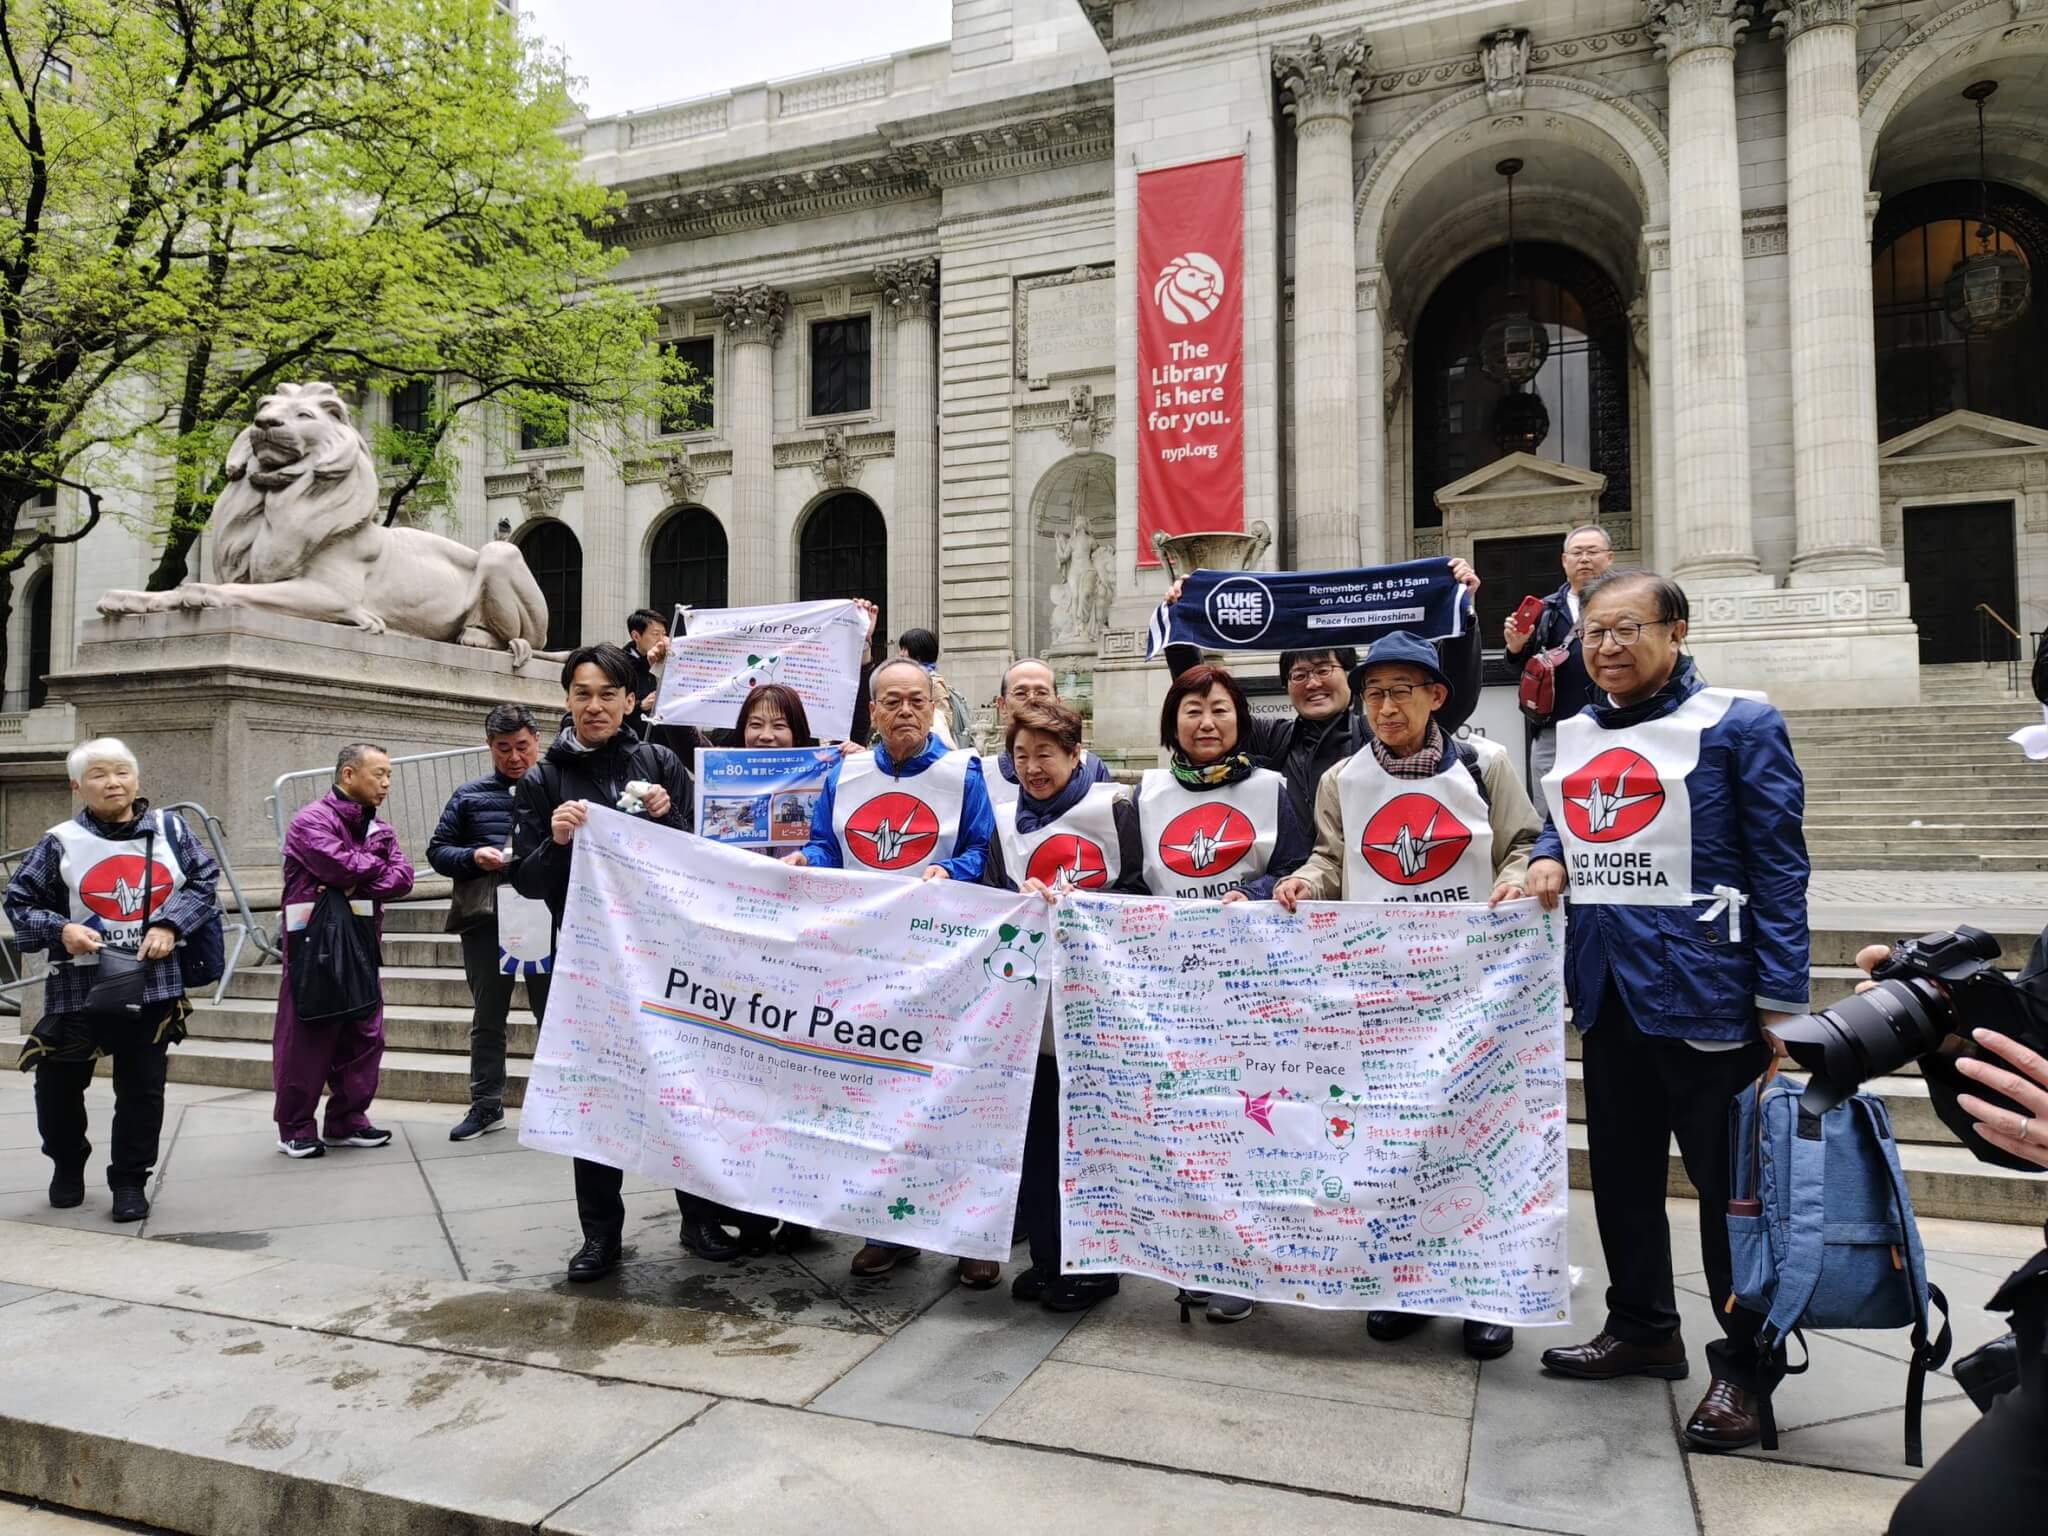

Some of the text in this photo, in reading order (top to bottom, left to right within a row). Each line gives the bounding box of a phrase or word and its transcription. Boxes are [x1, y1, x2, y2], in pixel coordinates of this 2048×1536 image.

[1168, 341, 1209, 361] The
[1152, 362, 1228, 386] Library
[1155, 386, 1225, 408] is here
[1148, 410, 1231, 433] for you.
[1161, 443, 1218, 461] nypl.org
[1372, 582, 1383, 590] at
[1386, 578, 1430, 589] 8:15am
[1216, 591, 1262, 608] NUKE
[1336, 594, 1361, 604] AUG
[1218, 609, 1262, 625] FREE
[1316, 612, 1416, 625] Peace from Hiroshima
[759, 622, 778, 634] for
[720, 830, 767, 840] パネル展
[1572, 852, 1652, 869] NO MORE
[1176, 887, 1198, 898] NO
[664, 968, 924, 1054] Pray for Peace
[675, 1030, 873, 1087] Join hands for a nuclear-free world
[1246, 1058, 1346, 1077] Pray for Peace
